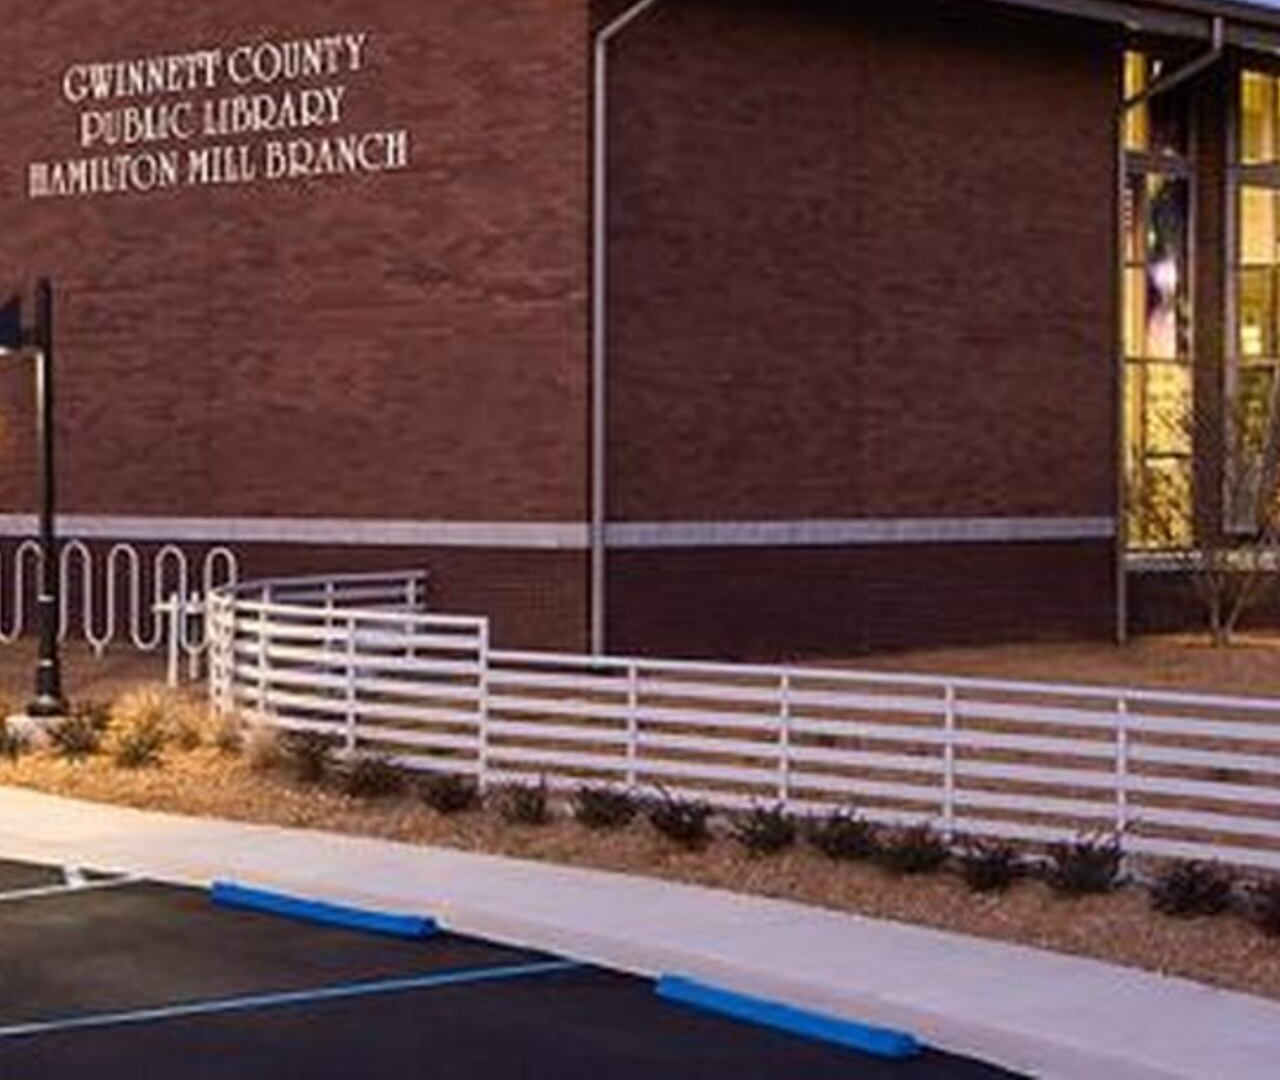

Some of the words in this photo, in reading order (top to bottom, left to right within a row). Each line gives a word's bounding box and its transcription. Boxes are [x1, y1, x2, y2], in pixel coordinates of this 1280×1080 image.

[63, 49, 220, 102] GWINNETT
[227, 33, 366, 84] COUNTY
[81, 101, 194, 147] PUBLIC
[203, 86, 345, 136] LIBRARY
[29, 151, 180, 198] HAMILTON
[188, 145, 258, 184] MILL
[266, 130, 409, 178] BRANCH
